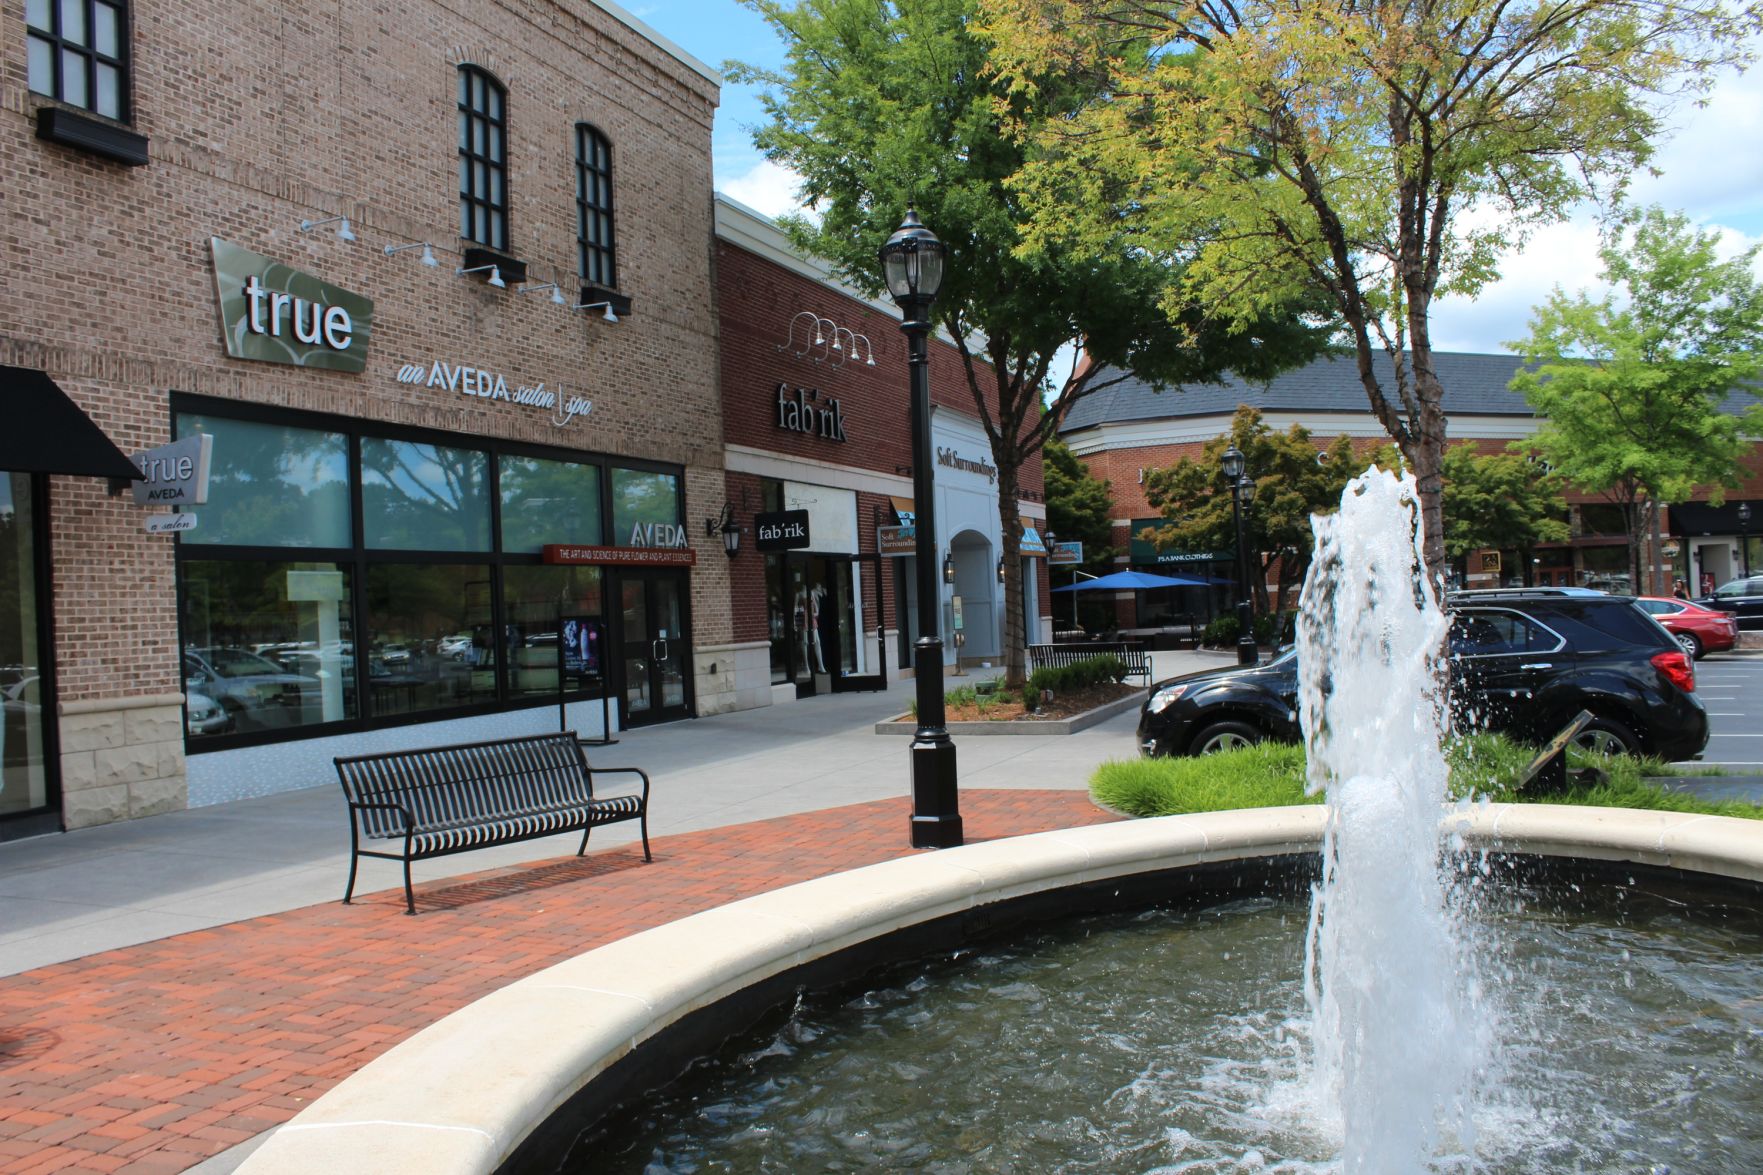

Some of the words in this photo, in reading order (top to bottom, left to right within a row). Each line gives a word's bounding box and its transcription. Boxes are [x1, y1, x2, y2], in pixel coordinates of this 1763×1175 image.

[245, 275, 353, 350] true
[397, 363, 425, 385] an
[427, 360, 510, 402] AVEDA
[513, 382, 555, 409] salon
[553, 395, 592, 427] spa
[777, 382, 849, 442] fab'rik
[140, 455, 194, 483] true
[937, 446, 953, 467] Soft
[953, 450, 996, 484] Surroundings
[147, 488, 185, 500] AVEDA
[162, 514, 190, 530] salon
[630, 520, 688, 548] AVEDA
[759, 522, 805, 540] fab'rik
[560, 549, 570, 559] THE
[571, 549, 581, 559] ART
[581, 550, 592, 560] AND
[593, 550, 612, 560] SCIENCE
[612, 551, 618, 560] OF
[619, 551, 631, 560] PURE
[631, 552, 648, 560] FLOWER
[649, 552, 659, 561] AND
[659, 553, 672, 562] PLANT
